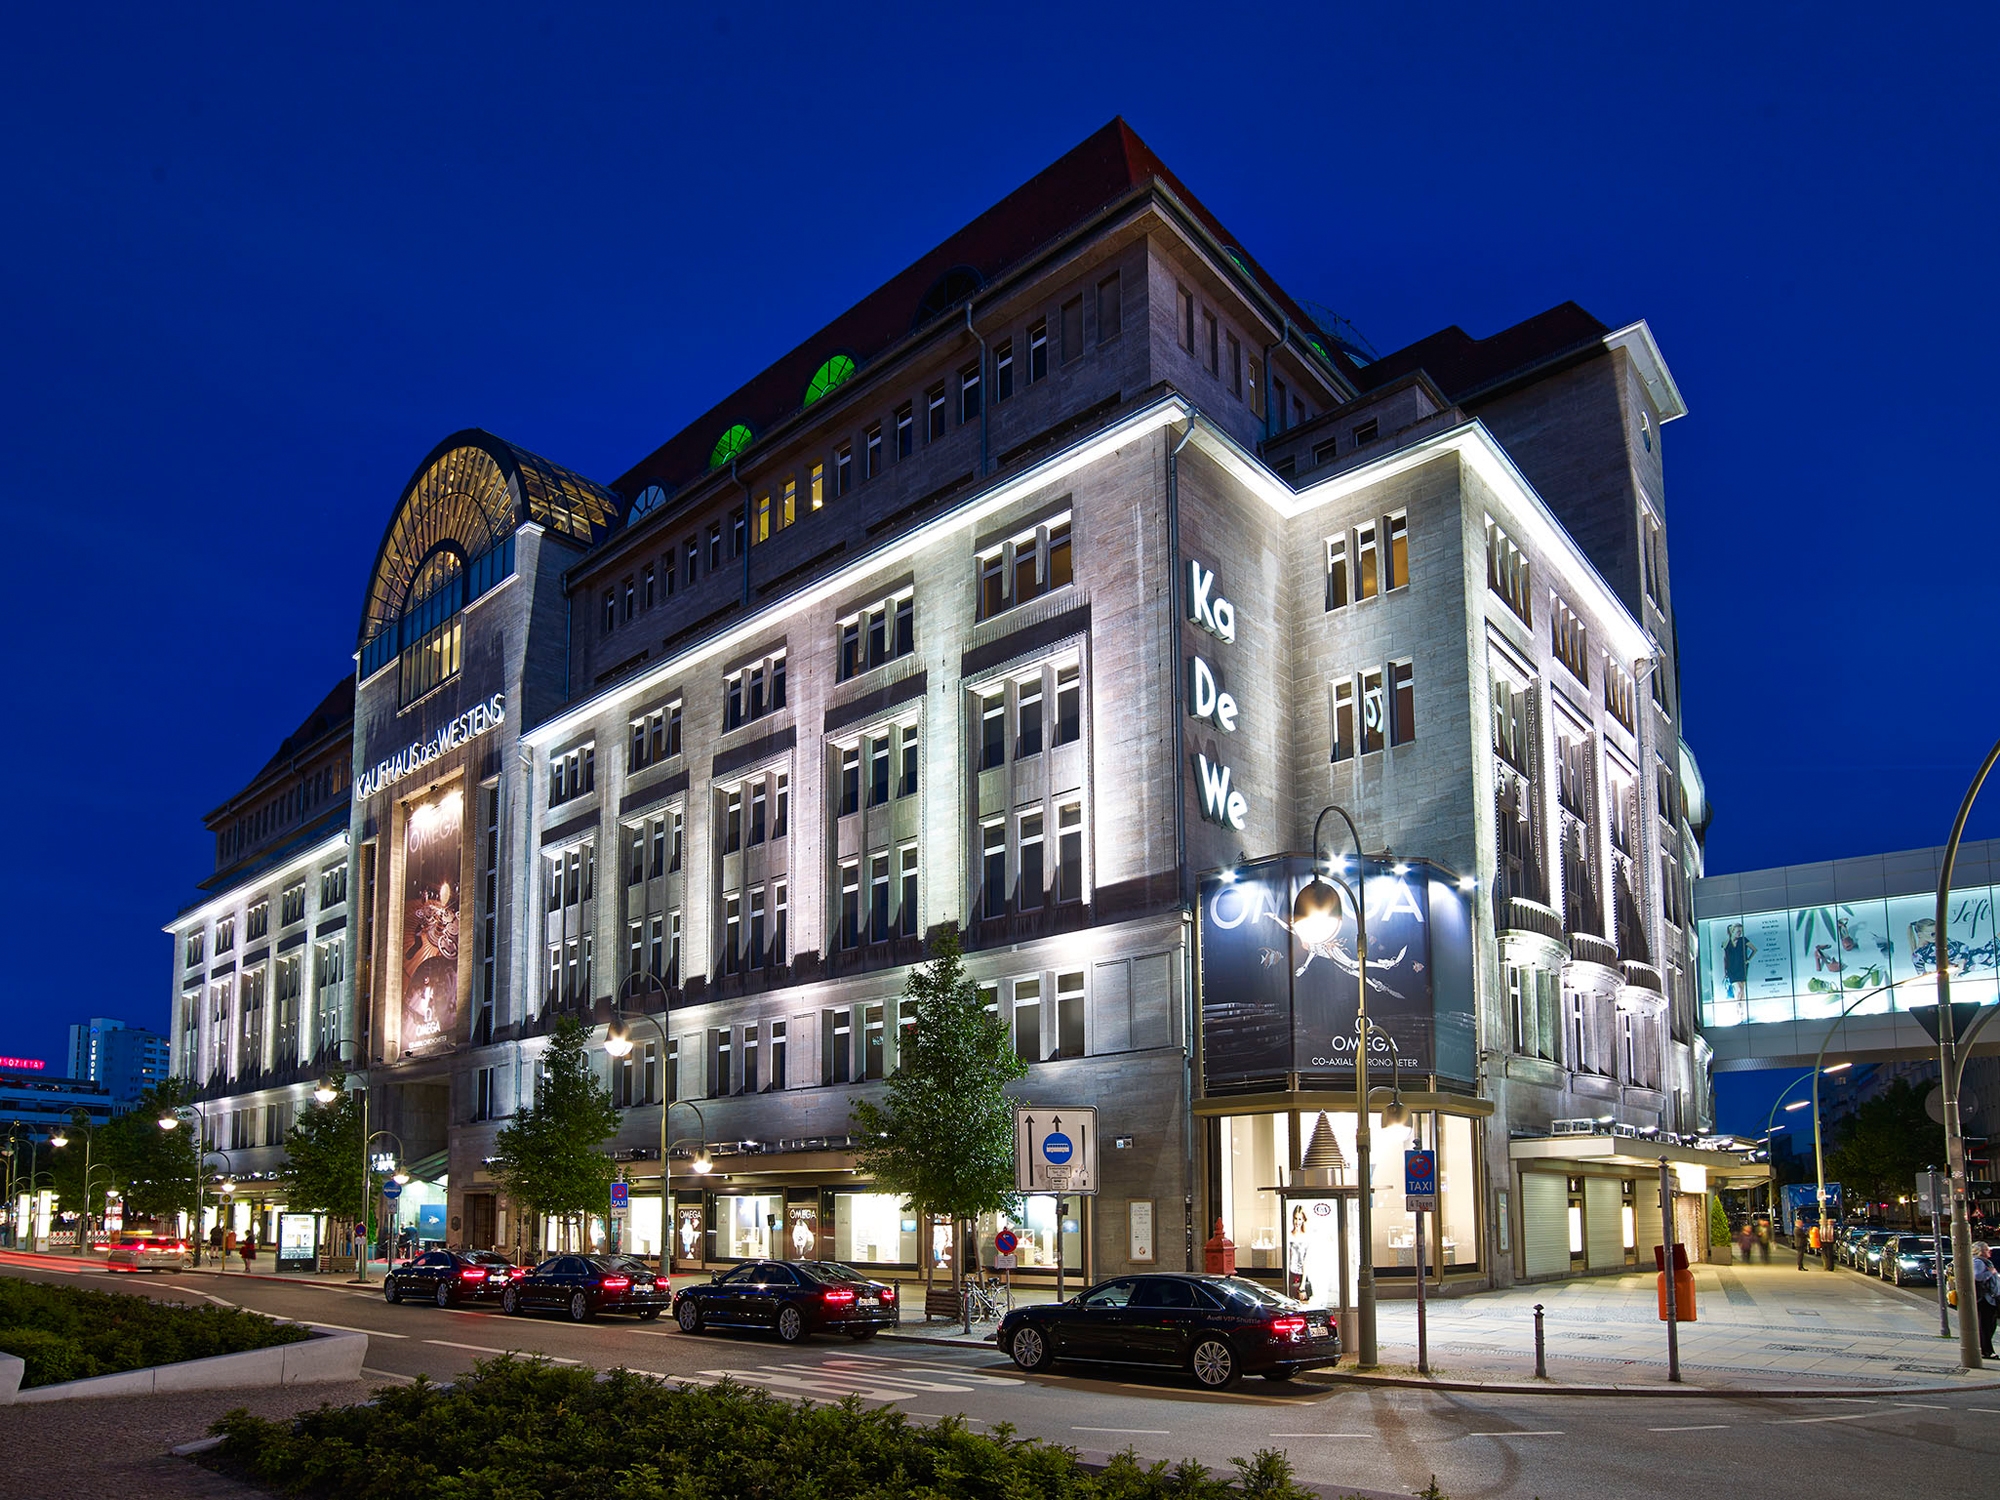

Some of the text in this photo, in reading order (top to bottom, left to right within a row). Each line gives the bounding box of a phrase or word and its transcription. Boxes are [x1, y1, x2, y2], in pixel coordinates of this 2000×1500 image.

[1189, 559, 1235, 644] Ka
[1190, 655, 1239, 733] De
[356, 742, 421, 801] KAUFHAUS
[437, 693, 505, 756] WESTENS
[1193, 752, 1249, 832] We
[1311, 1057, 1353, 1067] CO-AXIAL
[1408, 1181, 1432, 1191] TAXI
[679, 1210, 702, 1219] OMEGA
[790, 1209, 817, 1219] OMEGA
